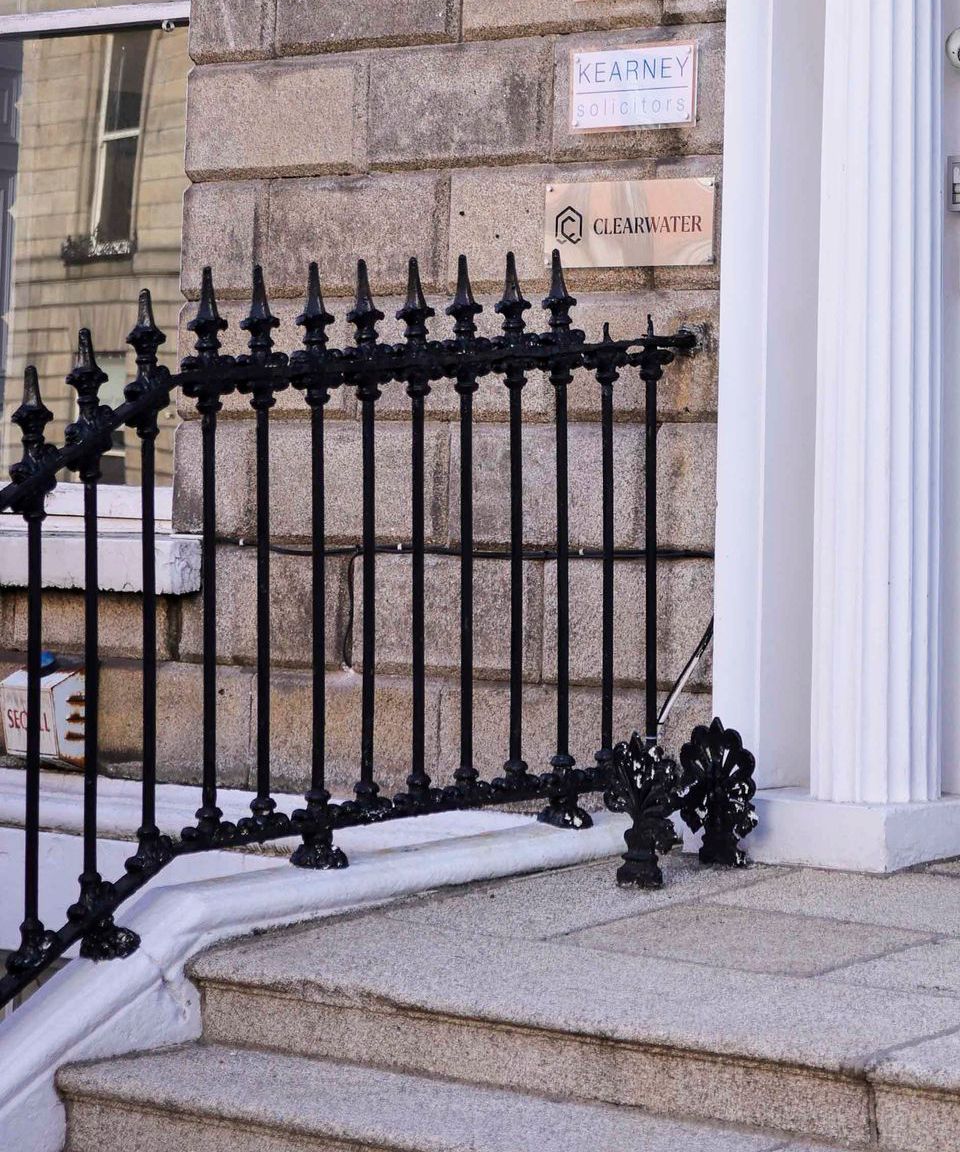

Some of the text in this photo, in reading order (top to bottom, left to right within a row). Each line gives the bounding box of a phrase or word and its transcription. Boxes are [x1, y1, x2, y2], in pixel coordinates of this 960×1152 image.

[578, 54, 690, 85] KEARNEY
[576, 96, 686, 118] solicitors
[593, 215, 703, 236] CLEARWATER
